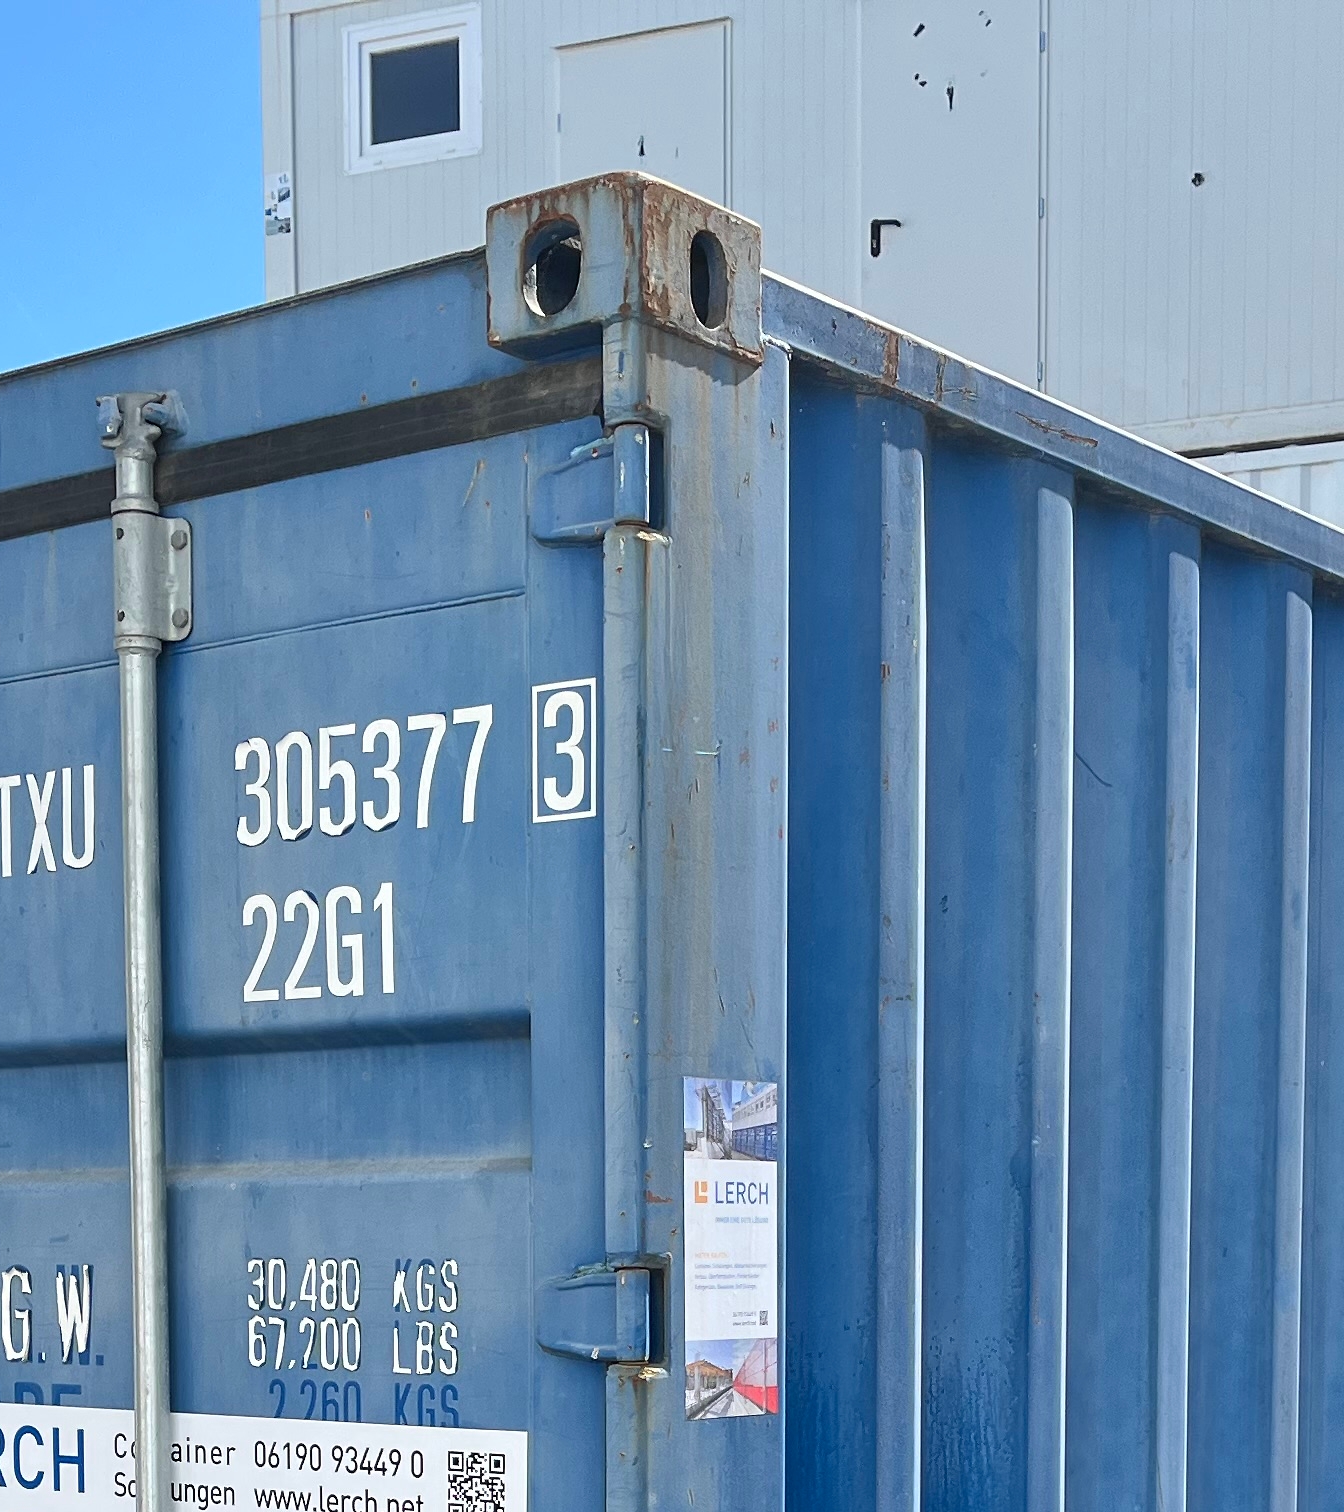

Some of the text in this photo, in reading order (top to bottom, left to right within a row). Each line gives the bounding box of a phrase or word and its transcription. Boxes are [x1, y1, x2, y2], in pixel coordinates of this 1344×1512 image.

[234, 703, 494, 847] 305377
[542, 690, 586, 812] 3
[242, 881, 397, 1004] 22G1
[715, 1181, 768, 1204] LERCH
[247, 1258, 361, 1312] 30,480
[392, 1258, 460, 1313] KGS
[248, 1314, 459, 1376] 67,200 LBS
[394, 1382, 460, 1428] KGS
[254, 1440, 323, 1473] 06190
[331, 1444, 403, 1478] 93449
[410, 1450, 425, 1480] 0
